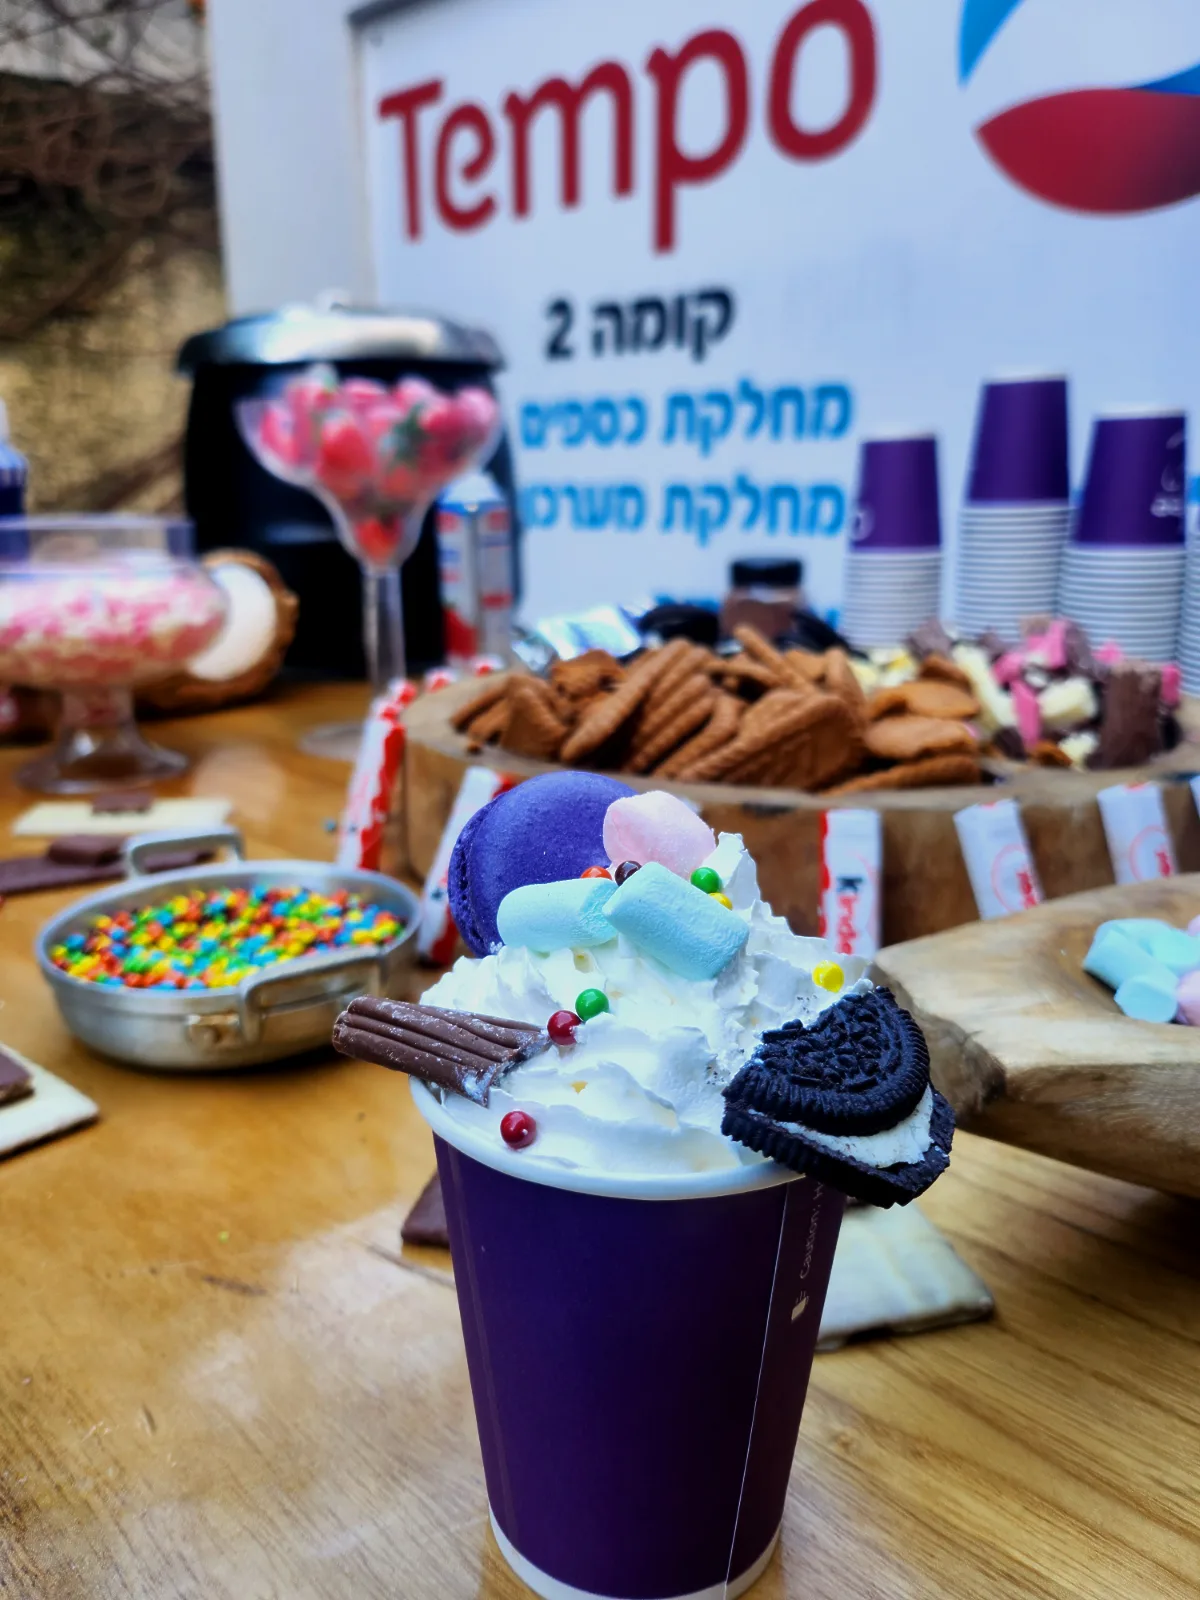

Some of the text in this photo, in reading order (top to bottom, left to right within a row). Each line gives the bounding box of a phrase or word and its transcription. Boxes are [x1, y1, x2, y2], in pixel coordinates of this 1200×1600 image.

[378, 0, 879, 255] Tempo
[546, 286, 736, 361] קומה 2
[662, 380, 853, 456] מחלקת
[521, 483, 647, 531] מערכו
[660, 474, 846, 544] מחלקת
